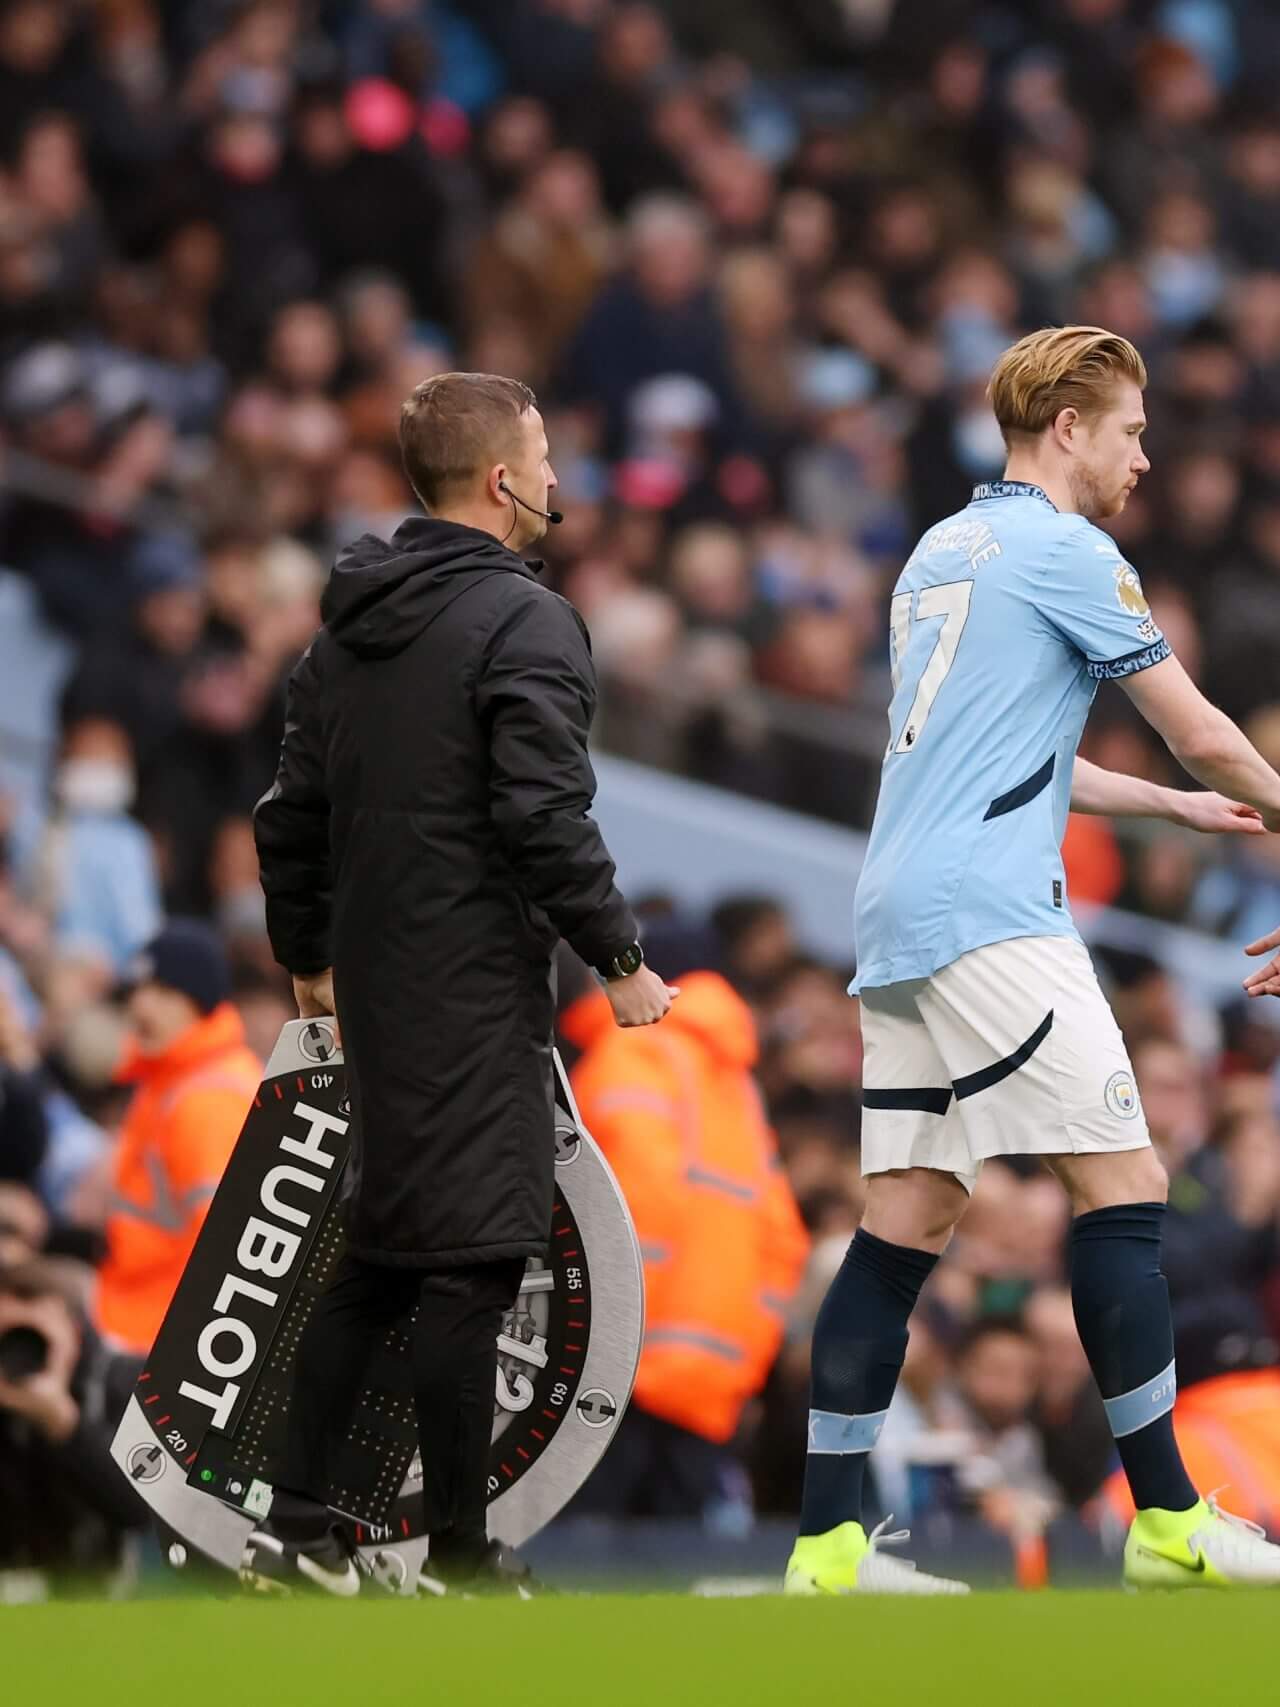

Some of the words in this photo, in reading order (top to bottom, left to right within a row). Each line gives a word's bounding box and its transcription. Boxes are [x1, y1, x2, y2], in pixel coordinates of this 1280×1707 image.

[311, 1073, 334, 1089] 40
[178, 1101, 349, 1430] HUBLOT
[566, 1267, 583, 1290] 55
[549, 1382, 568, 1405] 60
[165, 1430, 187, 1452] 20
